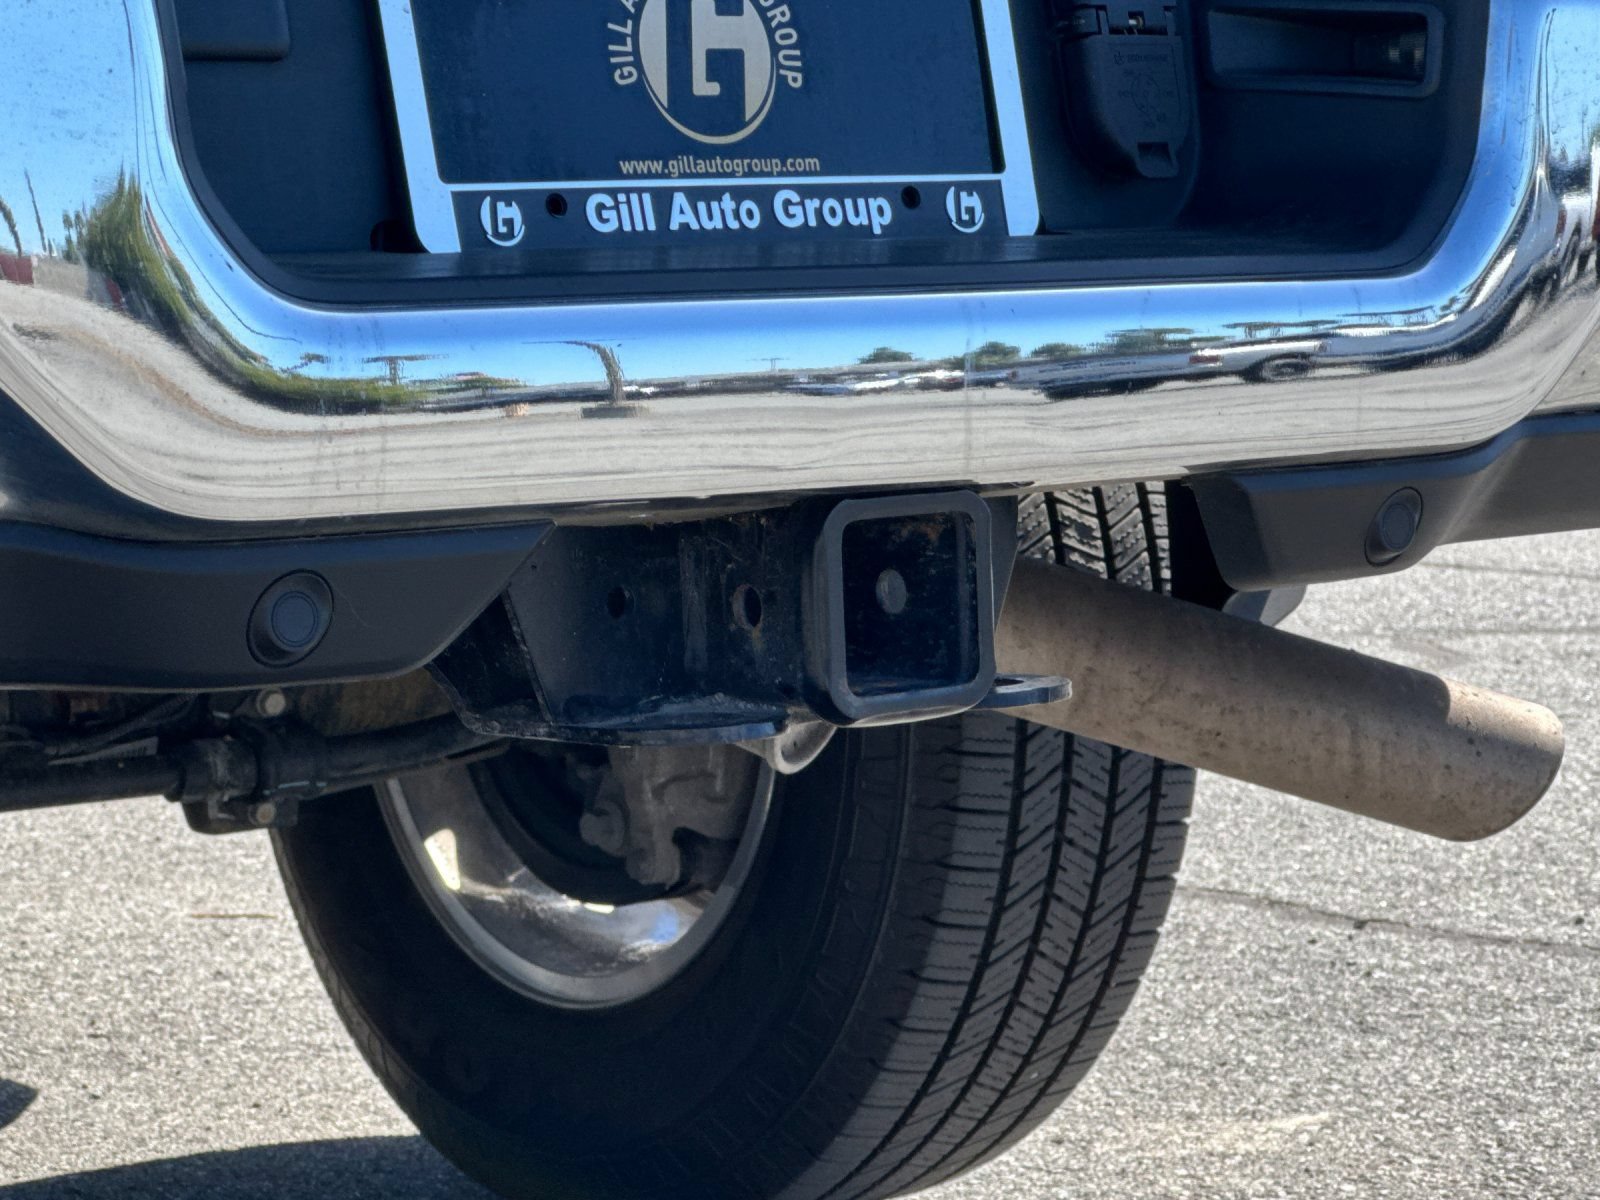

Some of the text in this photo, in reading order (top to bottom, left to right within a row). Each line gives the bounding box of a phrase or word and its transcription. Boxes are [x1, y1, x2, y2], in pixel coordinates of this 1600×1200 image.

[607, 19, 638, 86] GILL
[619, 155, 820, 177] www.gillautogroup.com
[585, 189, 892, 234] Gill Auto Group
